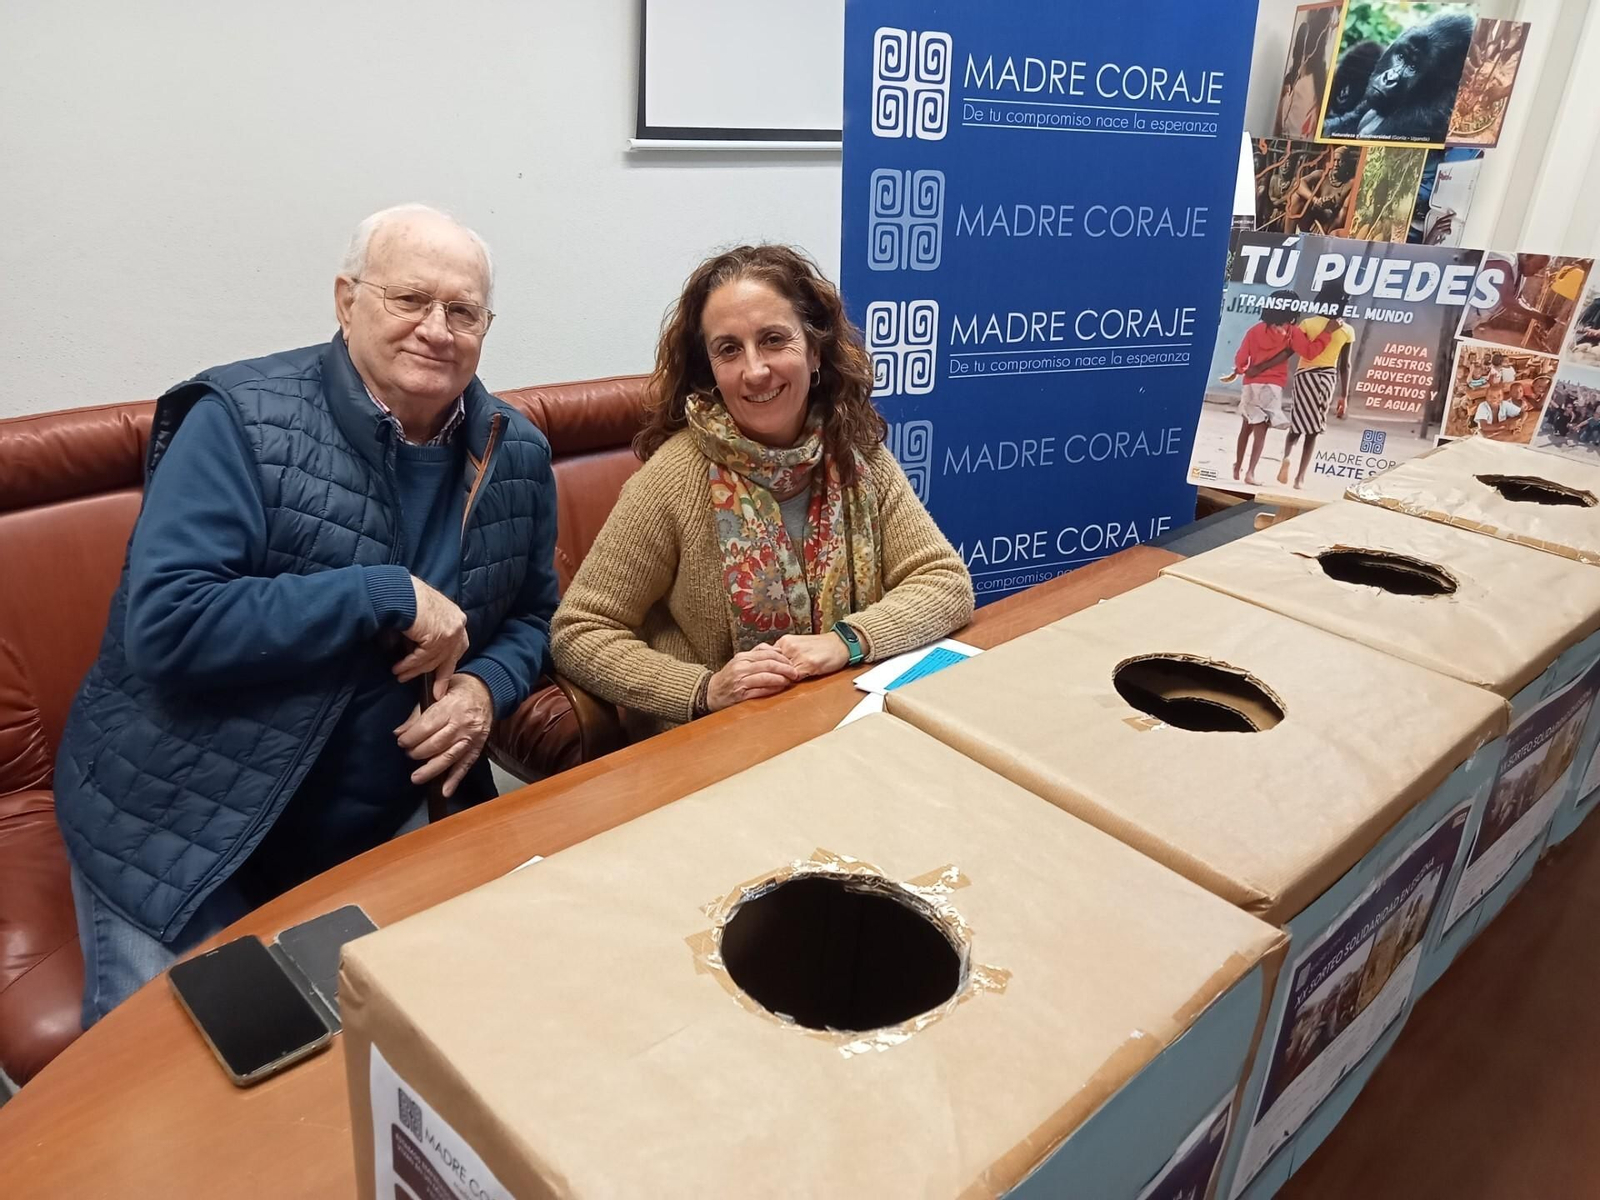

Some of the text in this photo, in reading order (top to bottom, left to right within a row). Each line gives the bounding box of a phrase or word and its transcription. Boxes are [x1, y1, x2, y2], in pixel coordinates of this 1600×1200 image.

[963, 53, 1225, 104] MADRE CORAJE
[962, 103, 1218, 134] De tu compromiso nace la esperanza
[956, 203, 1209, 238] MADRE CORAJE
[1240, 236, 1506, 310] TÚ PUEDES
[1239, 293, 1414, 325] TRANSFORMAR EL MUNDO
[950, 307, 1197, 346] MADRE CORAJE
[950, 350, 1190, 375] De tu compromiso nace la esperanza
[1366, 369, 1434, 386] PROYECTOS
[1373, 355, 1433, 372] NUESTROS
[1355, 381, 1438, 401] EDUCATIVOS Y
[1365, 396, 1421, 413] DE AGUA!
[943, 427, 1182, 476] MADRE CORAJE
[1315, 450, 1396, 470] MADRE COR
[1314, 462, 1364, 480] HAZTE
[976, 570, 1053, 590] compromiso
[1308, 953, 1343, 994] SORTEO
[1344, 898, 1400, 955] SOLIDARIDAD
[425, 1127, 467, 1184] MADRE
